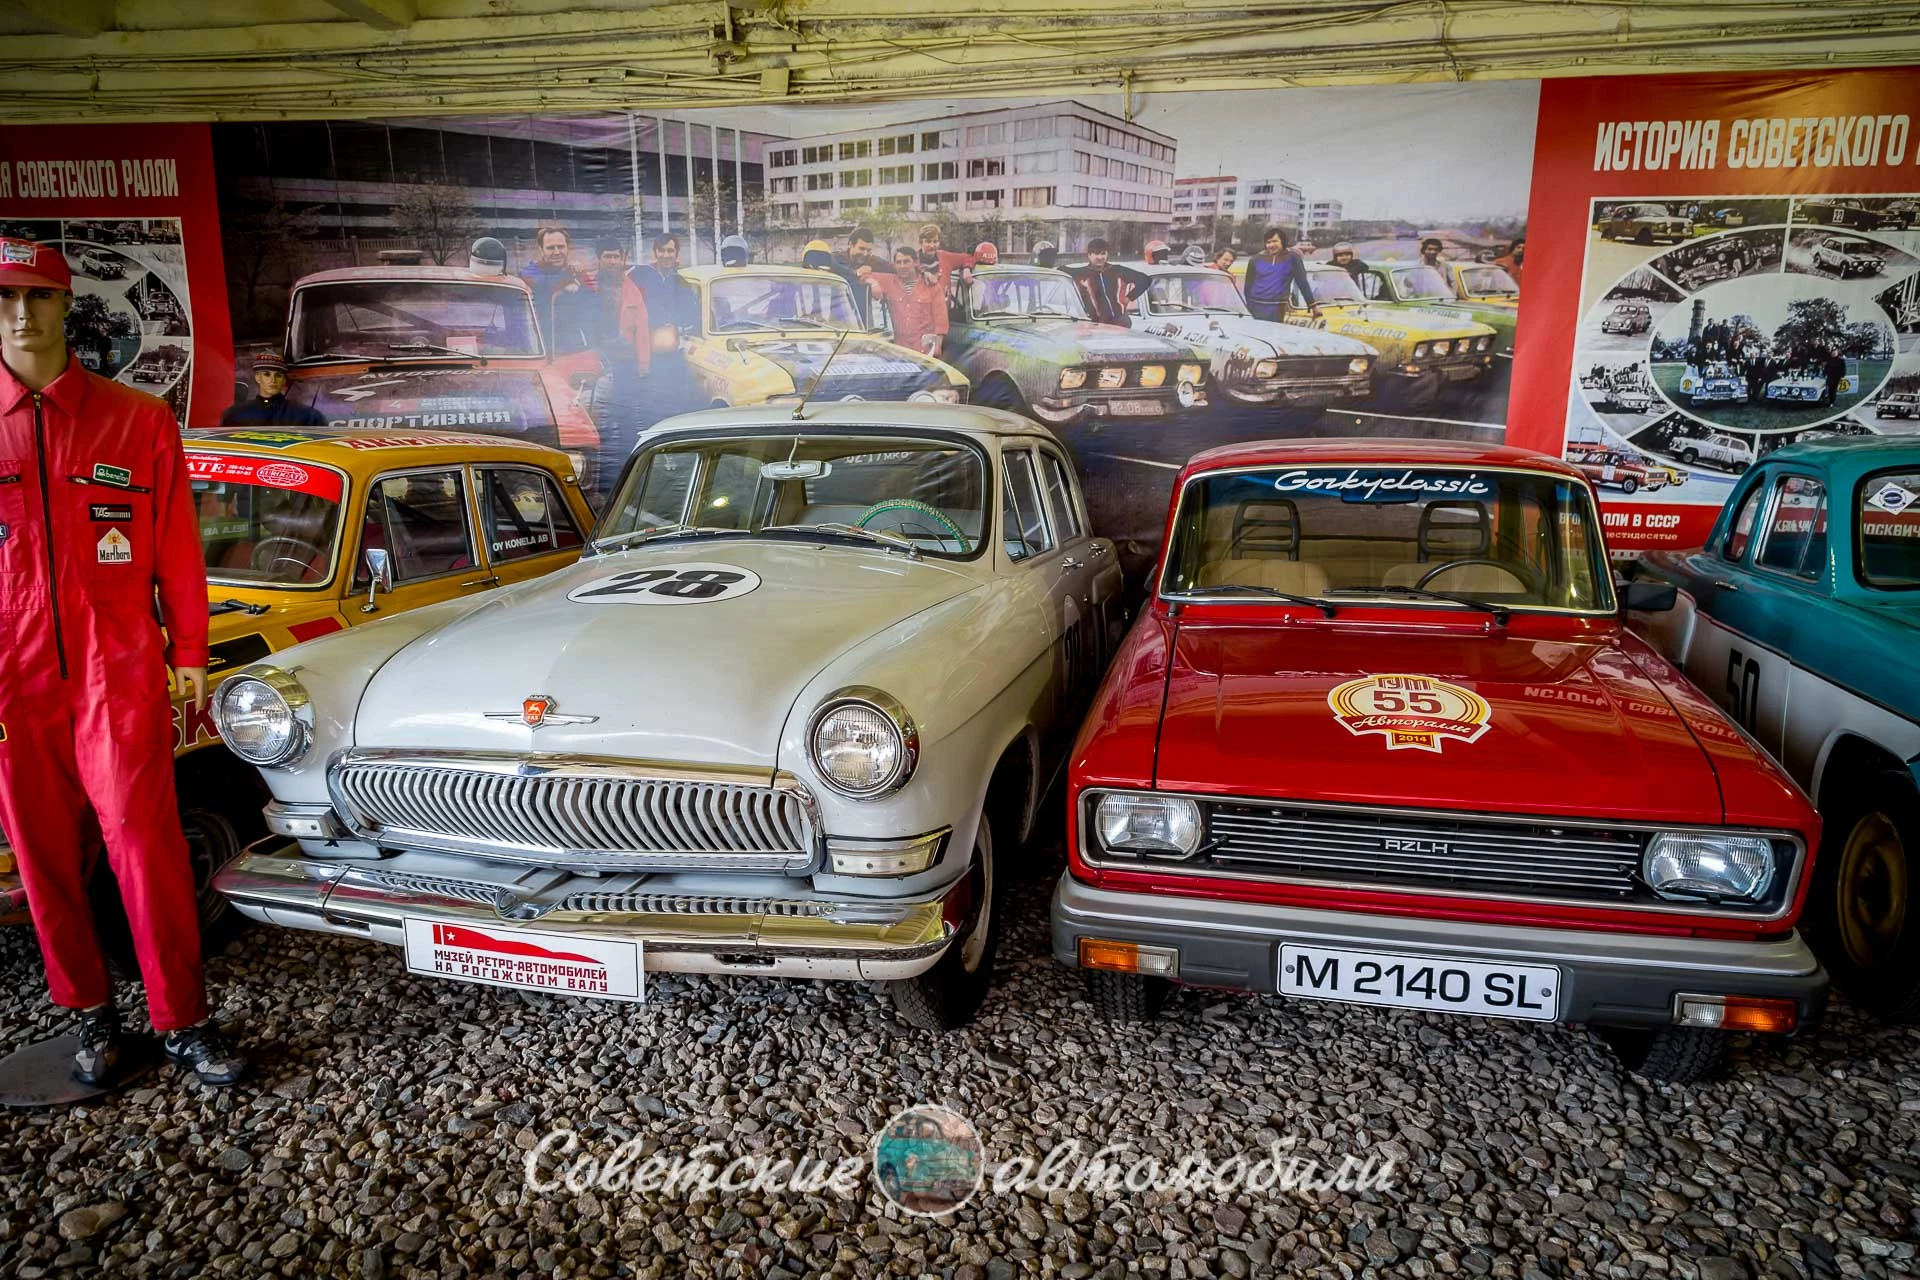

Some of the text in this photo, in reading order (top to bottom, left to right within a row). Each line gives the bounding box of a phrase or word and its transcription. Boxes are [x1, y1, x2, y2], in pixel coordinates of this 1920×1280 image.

[1594, 120, 1720, 171] ИСТОРИЯ
[1728, 114, 1910, 169] СОВЕТСКОГО
[16, 160, 118, 198] СОВЕТСКОГО
[121, 159, 179, 197] РАЛЛИ
[186, 461, 226, 473] ATE
[1274, 469, 1489, 499] Gorkyclassic
[92, 507, 111, 518] TAG
[1633, 514, 1642, 527] В
[1645, 515, 1680, 529] СССР
[493, 534, 549, 552] OY KONELA AB
[1606, 532, 1678, 541] естидесятые
[99, 545, 131, 561] Marlboro
[575, 569, 746, 599] 28
[1373, 691, 1443, 714] 55
[1727, 648, 1761, 737] 50
[1352, 715, 1472, 733] Авторалли
[1399, 734, 1427, 743] 2014
[434, 949, 607, 981] МУЗЕЙ РЕТРО-АВТОМОБИЛЕЙ
[435, 962, 608, 992] НА РОГОЖСКОМ ВАЛУ
[1295, 955, 1542, 1010] M 2140 SL
